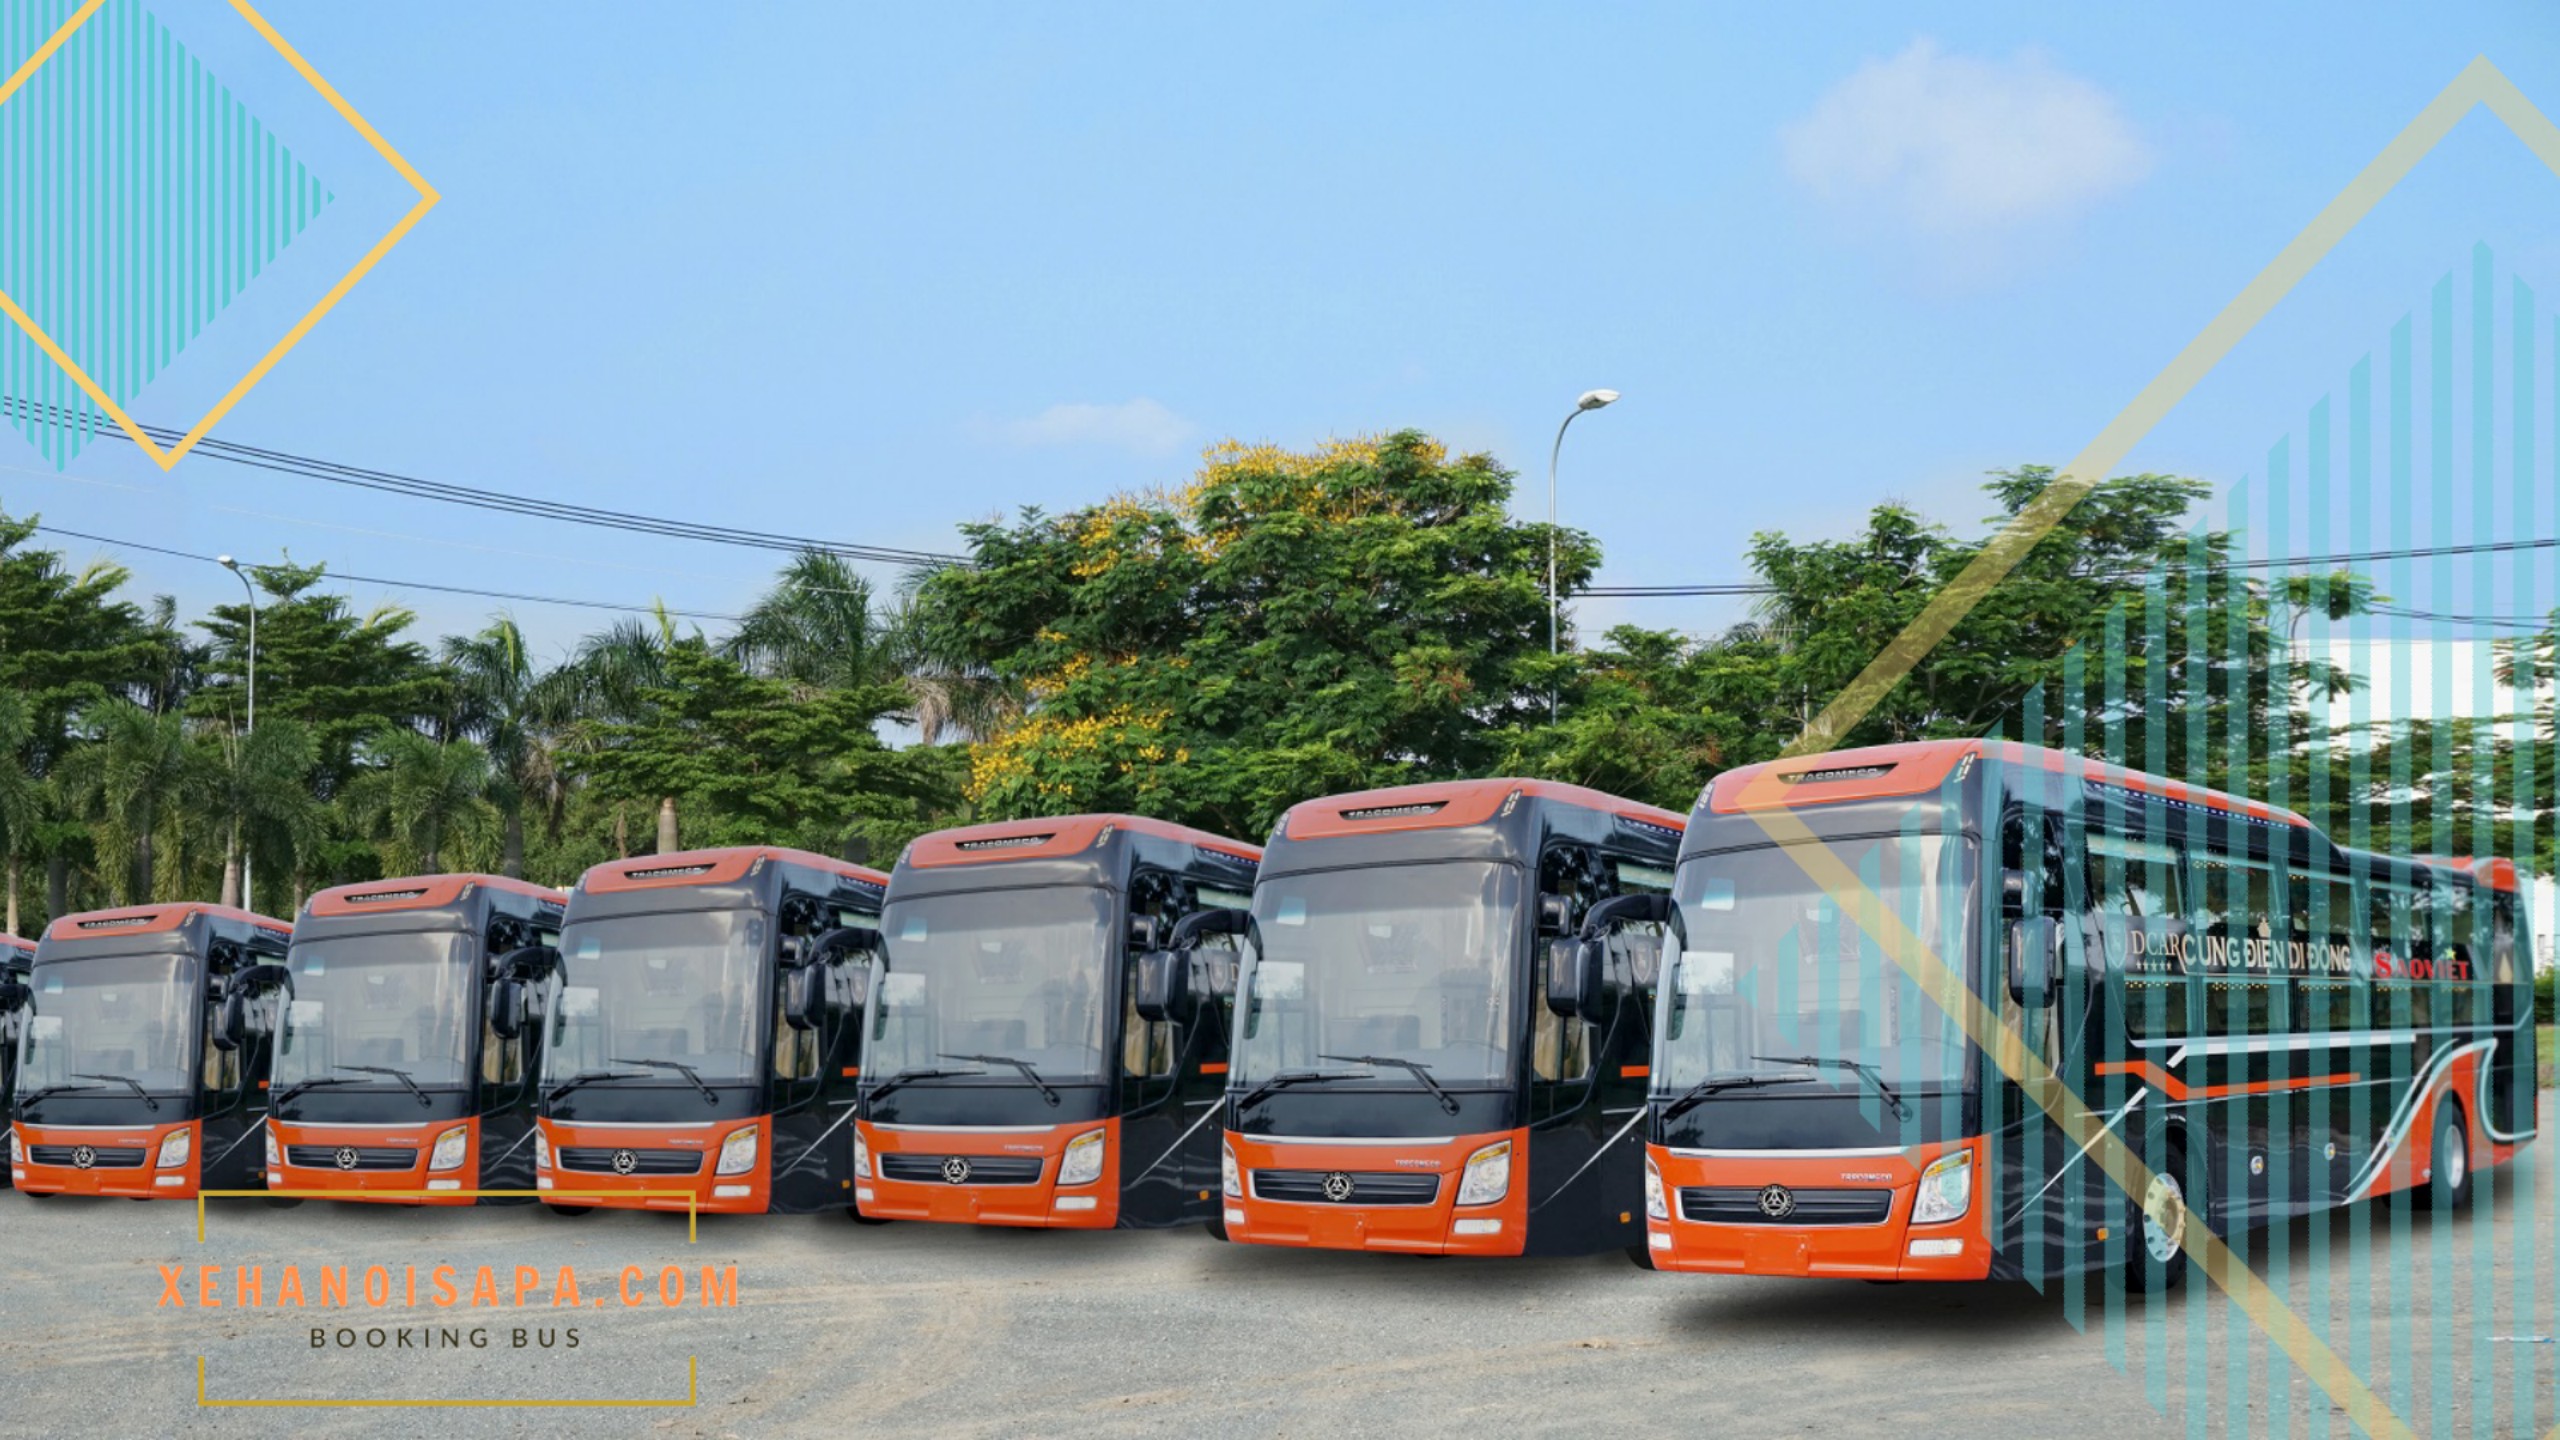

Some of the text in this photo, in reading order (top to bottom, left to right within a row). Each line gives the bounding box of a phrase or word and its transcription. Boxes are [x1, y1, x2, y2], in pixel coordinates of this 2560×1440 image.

[1788, 767, 1878, 782] TRACOMECO
[1348, 805, 1432, 817] TRACOMECO
[2182, 934, 2240, 967] CUNG
[2288, 941, 2305, 969] DI
